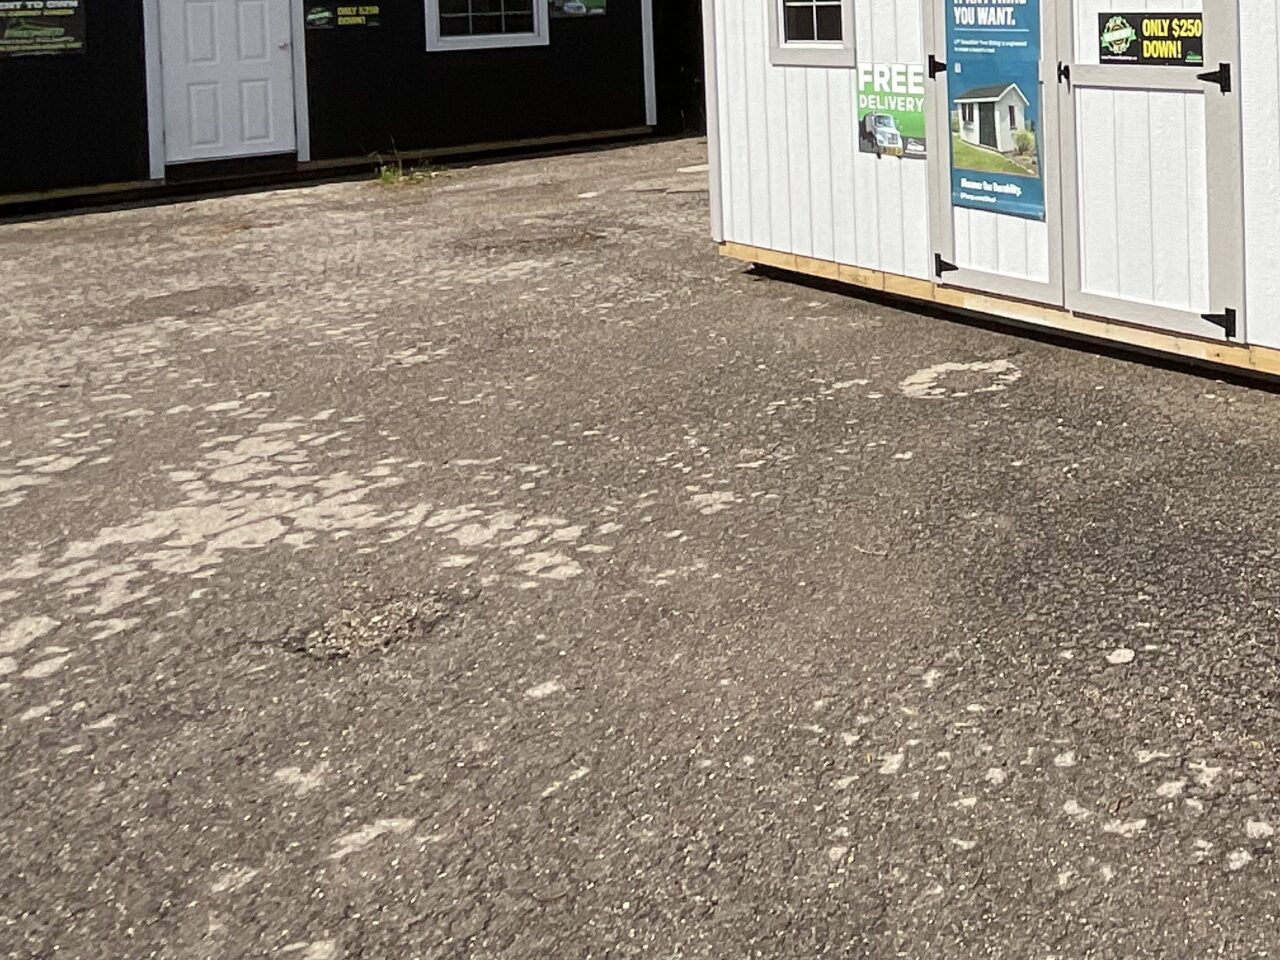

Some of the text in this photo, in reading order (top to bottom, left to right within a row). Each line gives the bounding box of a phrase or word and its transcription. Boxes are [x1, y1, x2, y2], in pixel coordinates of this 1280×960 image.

[954, 6, 1016, 26] YOU WANT.
[1142, 18, 1169, 37] ONLY
[1171, 17, 1202, 38] $250
[1142, 40, 1182, 59] DOWN!
[858, 63, 925, 94] FREE
[859, 94, 924, 112] DELIVERY
